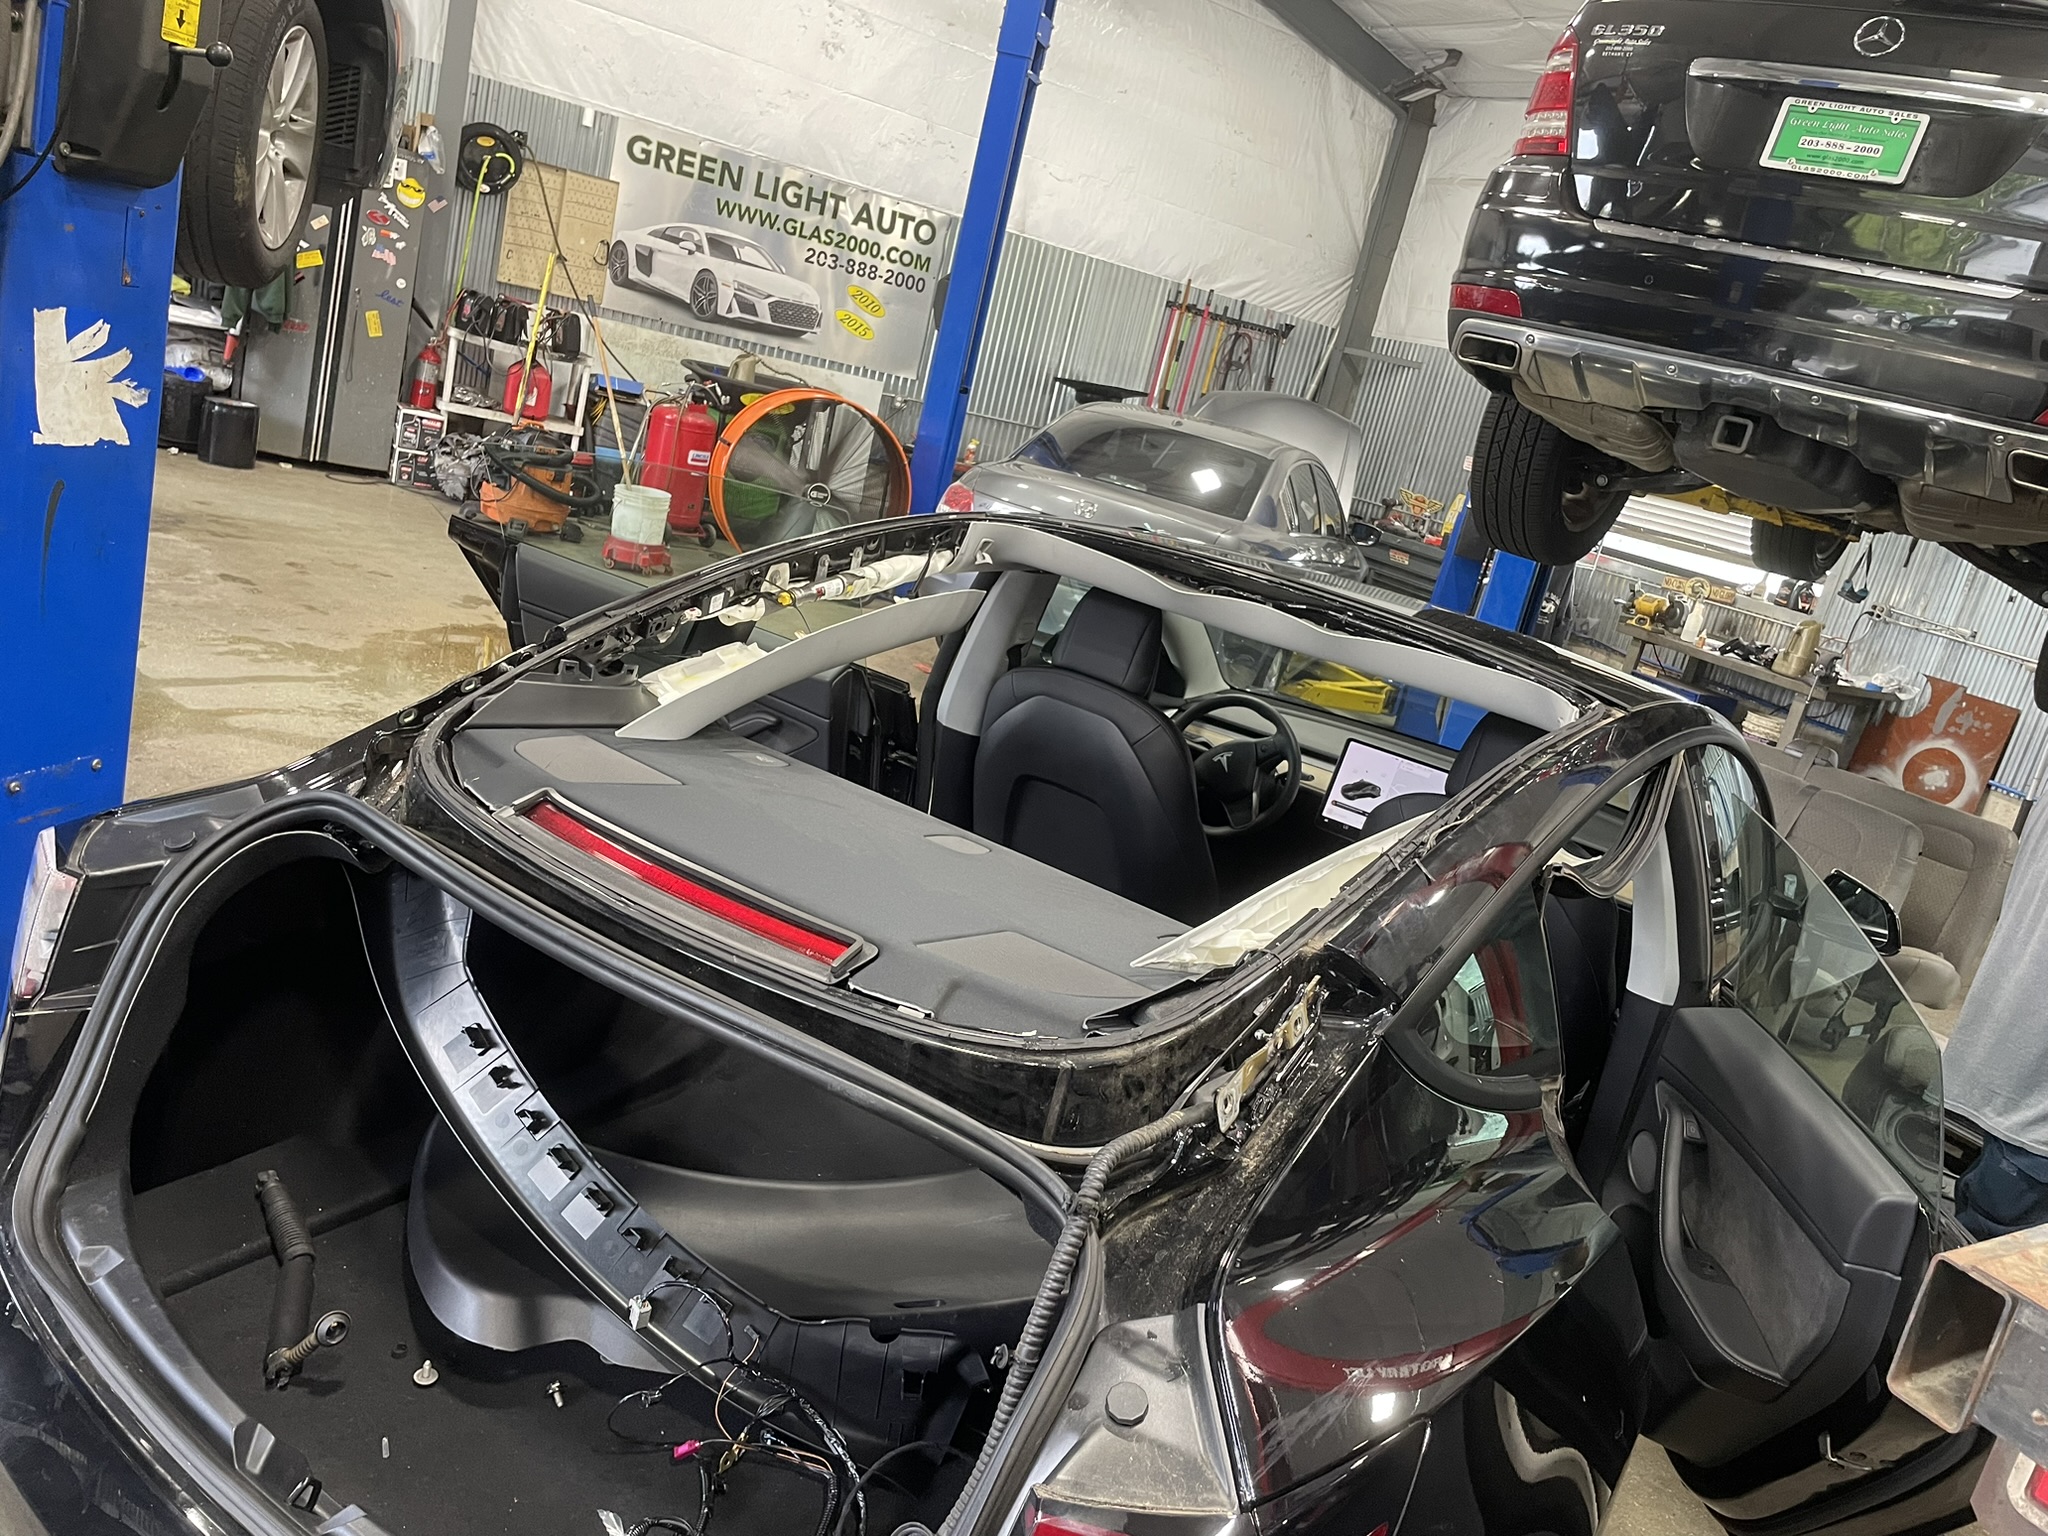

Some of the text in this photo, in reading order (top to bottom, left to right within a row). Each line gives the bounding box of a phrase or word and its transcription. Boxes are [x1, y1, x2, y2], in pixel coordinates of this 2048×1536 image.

[1794, 98, 1919, 119] GREEN LIGHT AUTO SALES
[1790, 117, 1820, 128] Green
[1822, 120, 1850, 132] Light
[1851, 124, 1880, 135] Auto
[1882, 128, 1908, 139] Sales
[1800, 138, 1881, 155] 203-888-2000
[1791, 164, 1869, 180] GLAS2000.COM
[627, 135, 937, 246] GREEN LIGHT AUTO
[716, 197, 932, 273] WWW.GLAS2000.COM
[804, 247, 926, 293] 203-888-2000
[851, 289, 882, 314] 2010
[839, 313, 871, 337] 2015
